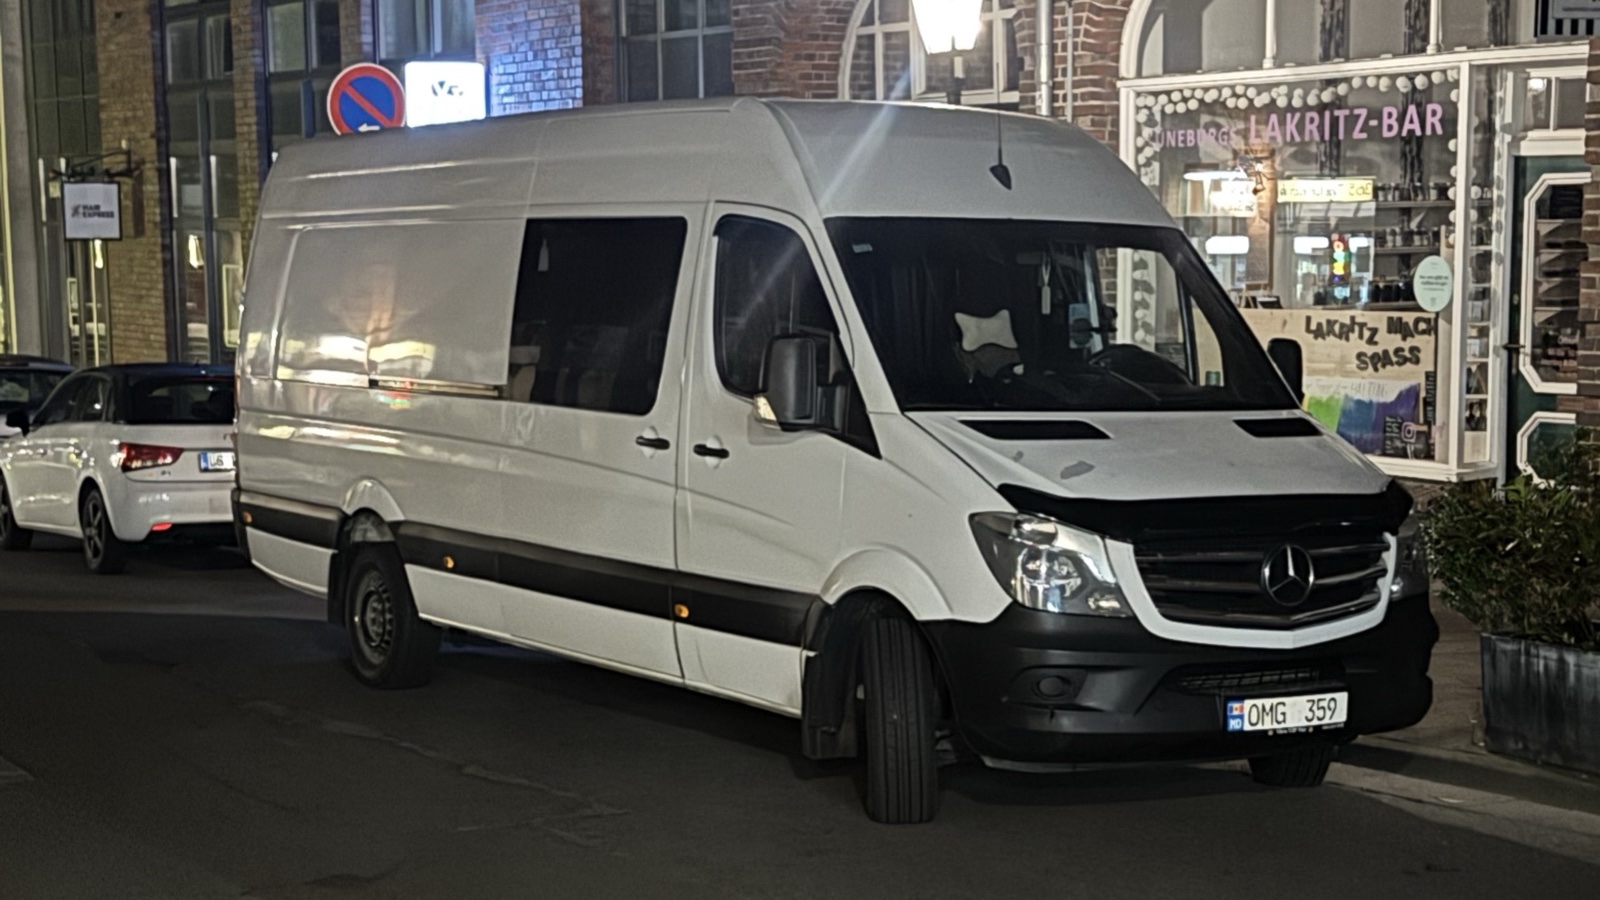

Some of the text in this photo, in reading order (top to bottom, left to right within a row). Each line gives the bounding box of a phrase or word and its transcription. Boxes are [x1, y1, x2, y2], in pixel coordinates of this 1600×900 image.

[1249, 103, 1444, 145] LAKRITZ-BAR
[1304, 314, 1380, 346] LAKRITZ
[1355, 345, 1423, 373] SPASS
[1229, 717, 1242, 730] MD
[1247, 696, 1338, 727] OMG 359
